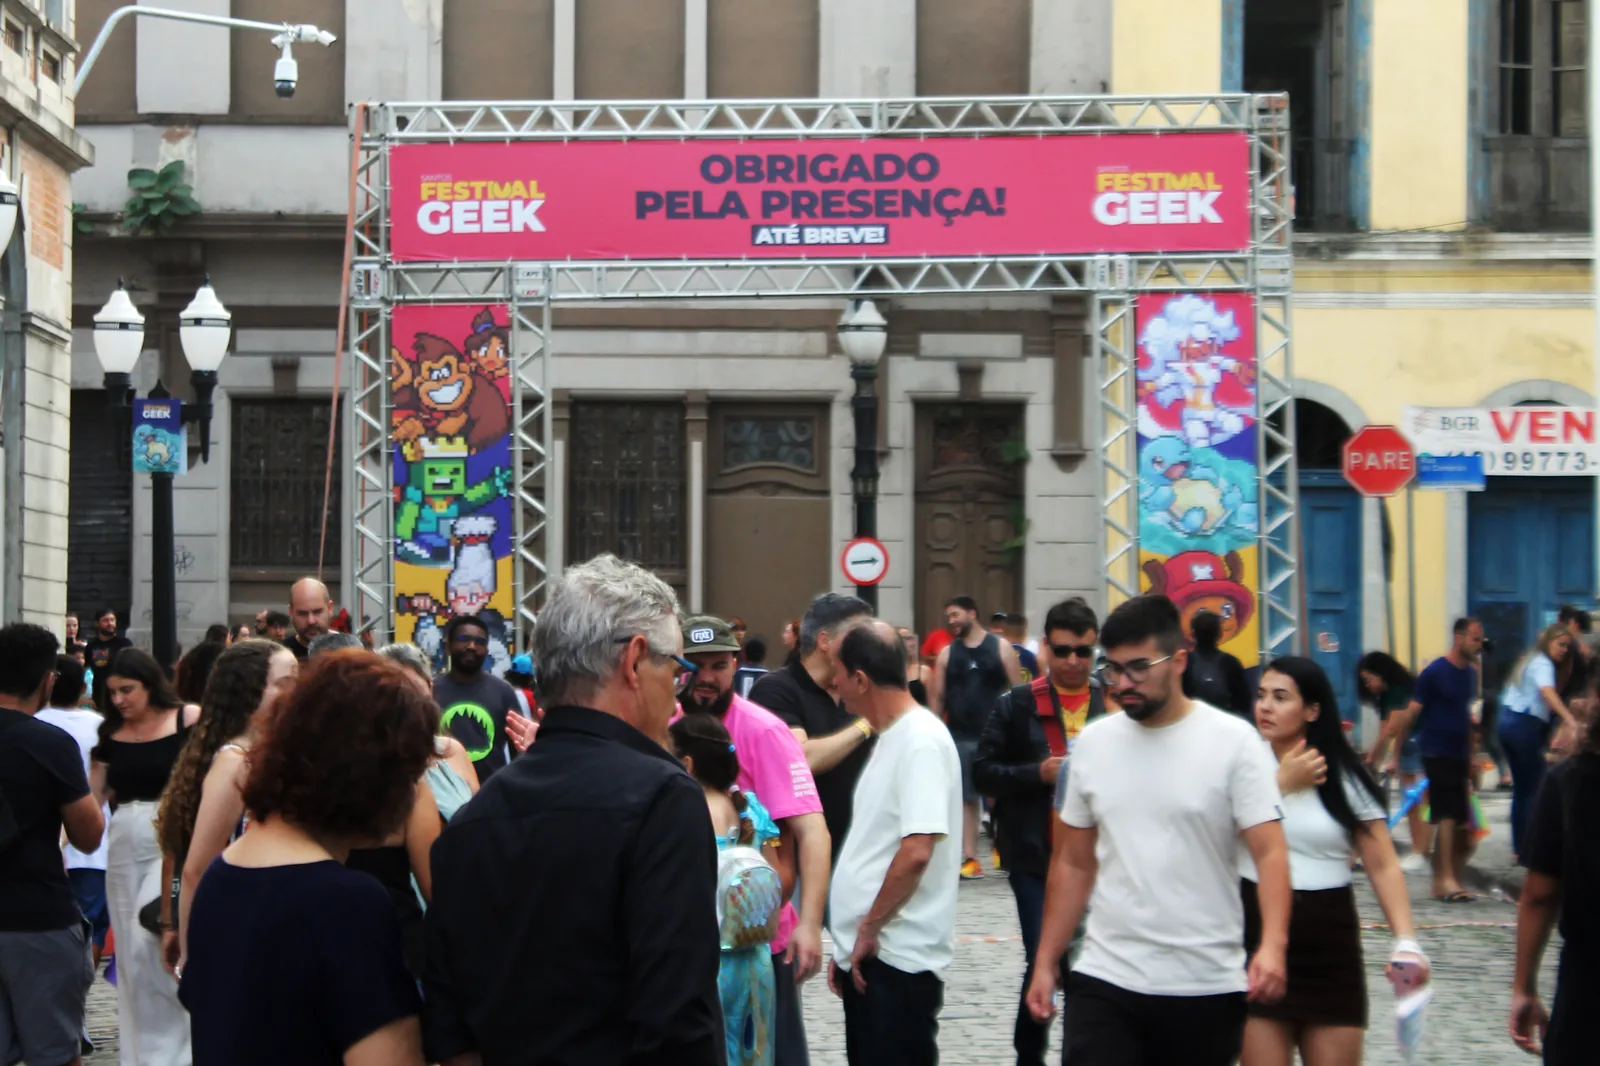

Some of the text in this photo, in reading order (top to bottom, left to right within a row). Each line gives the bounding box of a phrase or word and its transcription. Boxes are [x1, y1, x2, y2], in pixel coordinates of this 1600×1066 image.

[700, 153, 940, 184] OBRIGADO
[420, 180, 546, 201] FESTIVAL
[1097, 171, 1223, 192] FESTIVAL
[417, 200, 546, 235] GEEK
[635, 187, 1006, 227] PELA PRESENÇA!
[1092, 191, 1224, 225] GEEK
[756, 225, 886, 245] ATÉ BREVE!
[142, 410, 171, 419] GEEK
[1440, 416, 1480, 431] BGR
[1349, 451, 1412, 472] PARE
